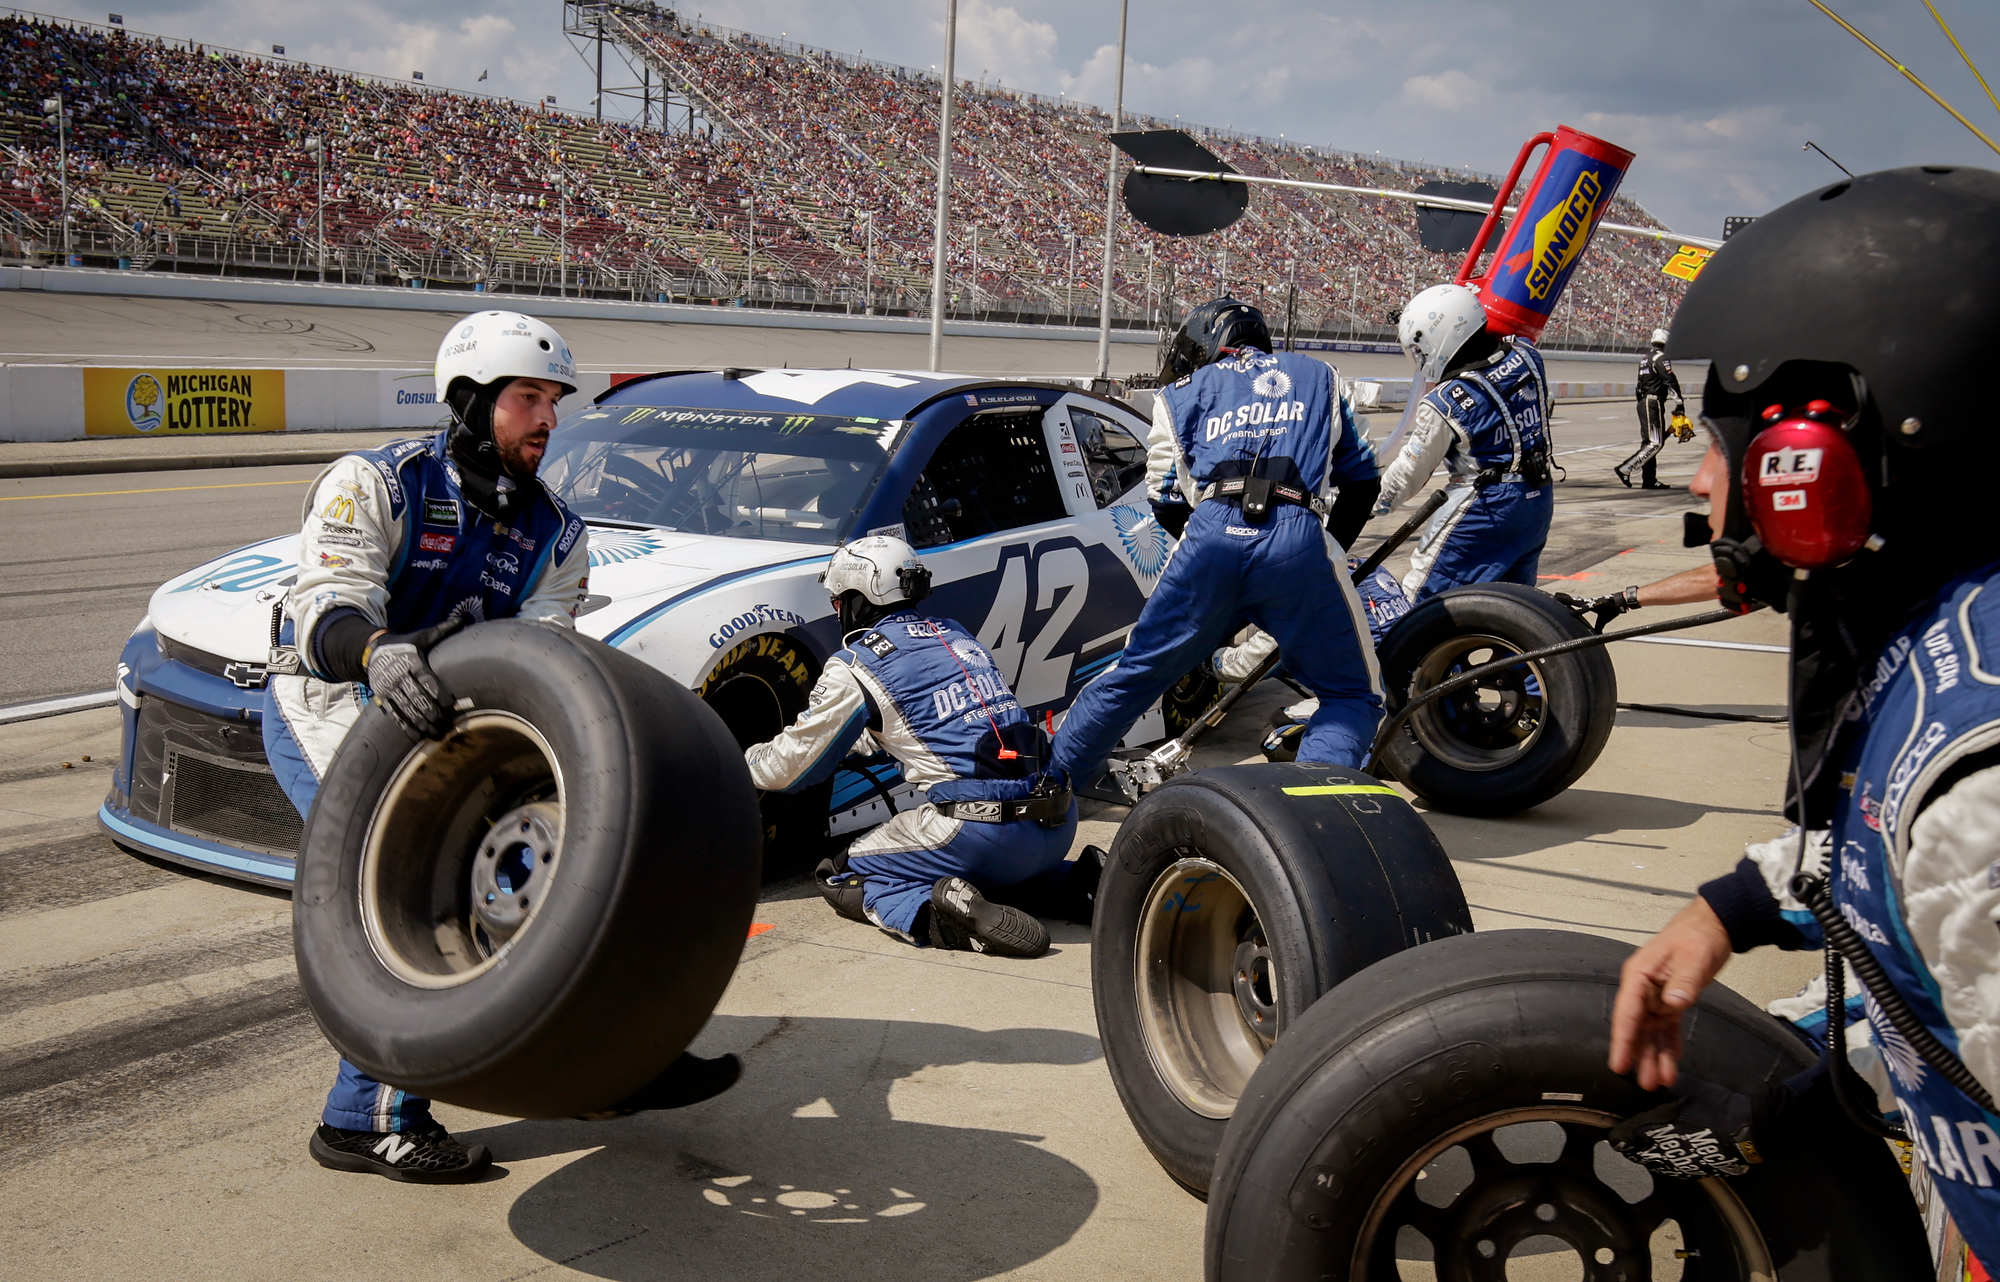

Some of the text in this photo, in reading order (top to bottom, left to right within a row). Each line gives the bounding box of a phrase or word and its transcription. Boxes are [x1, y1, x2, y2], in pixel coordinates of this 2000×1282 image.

[1530, 176, 1600, 295] SUNOCO
[1662, 244, 1714, 282] 2
[167, 375, 252, 398] MICHIGAN
[168, 396, 253, 429] LOTTERY
[1206, 400, 1305, 442] DC SOLAR
[1779, 495, 1800, 507] 3M
[907, 621, 952, 638] PRICE
[974, 547, 1089, 708] 42
[872, 640, 894, 655] PC1
[933, 682, 967, 720] DC
